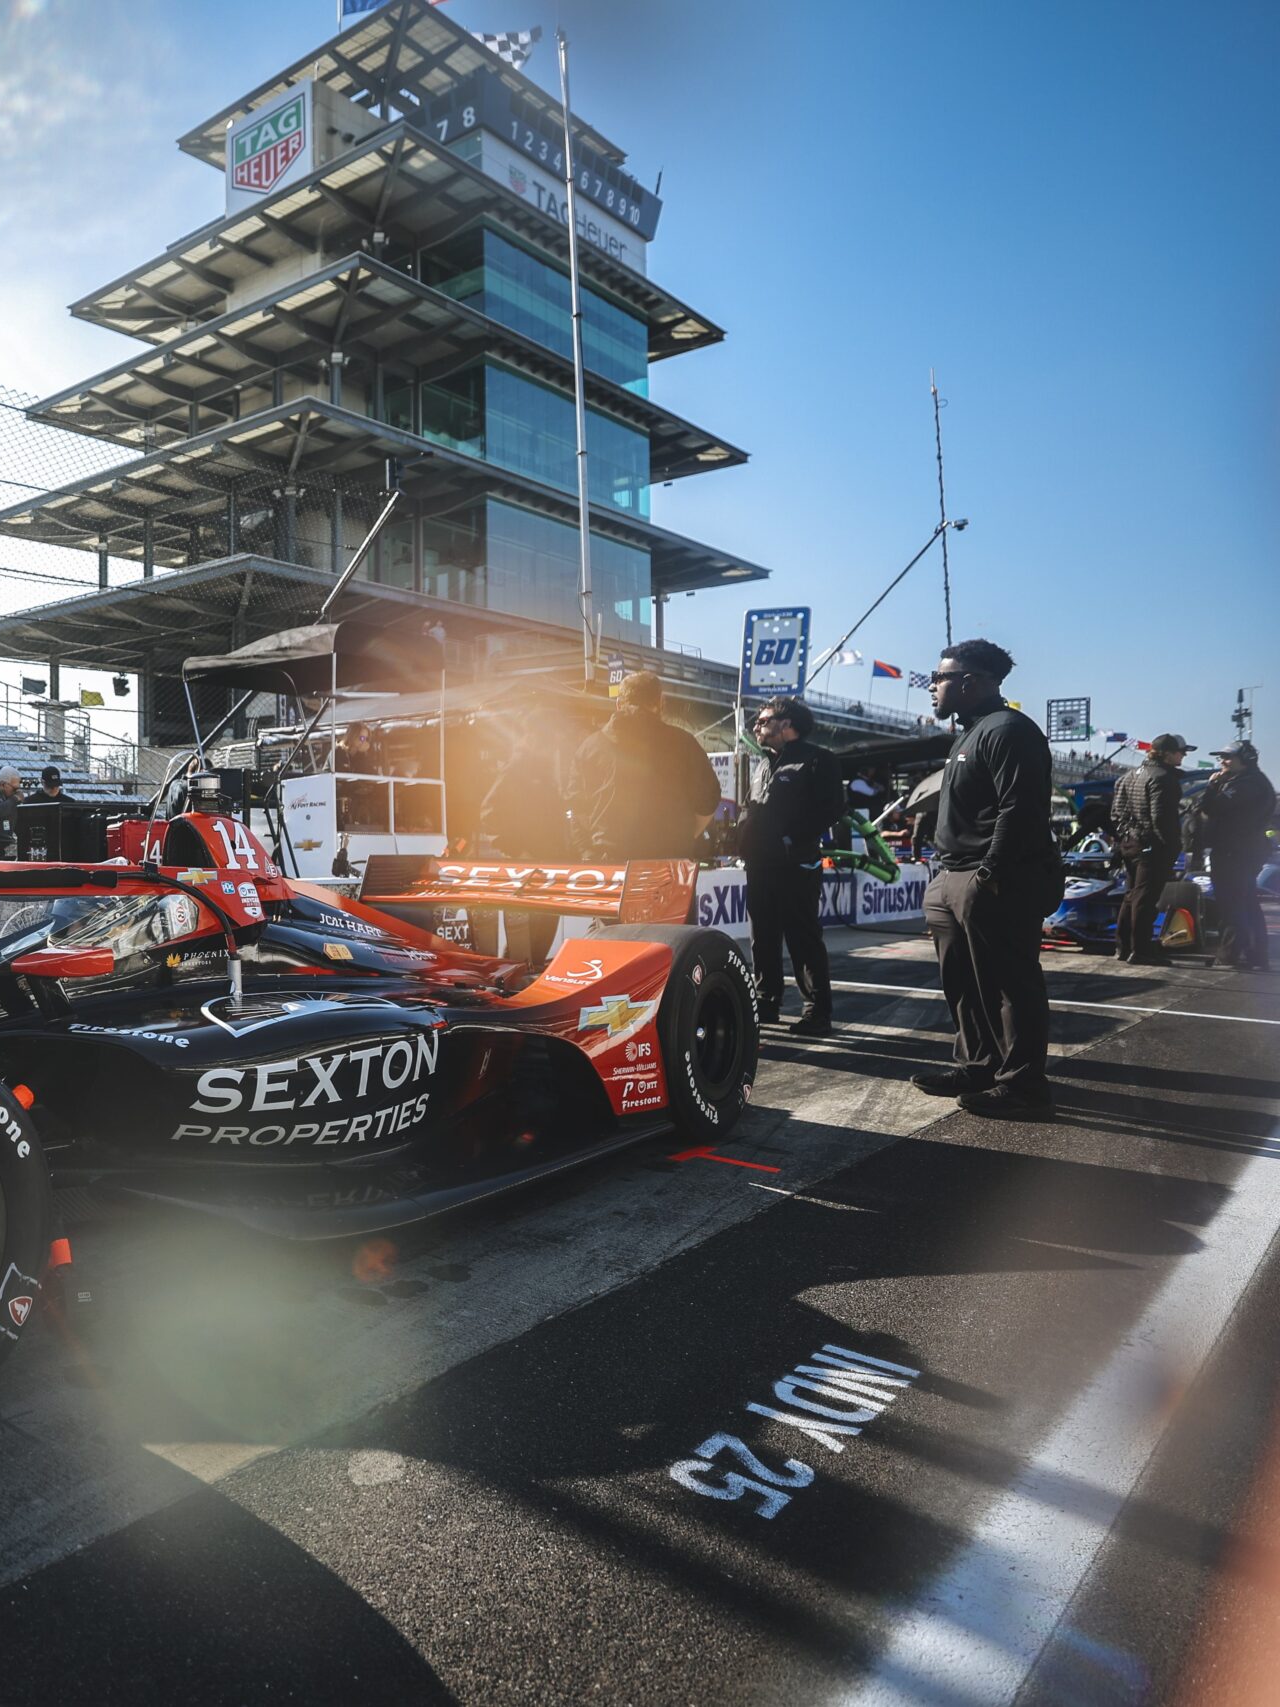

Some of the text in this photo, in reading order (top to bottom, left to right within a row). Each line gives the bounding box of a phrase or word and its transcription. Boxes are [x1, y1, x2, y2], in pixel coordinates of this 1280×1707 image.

[239, 106, 297, 156] TAG
[436, 106, 476, 142] 7 8
[236, 133, 300, 188] HEUER
[511, 121, 640, 226] 1 2 3 4 6 7 8 9 10
[754, 638, 797, 666] 60
[212, 820, 259, 870] 14
[862, 880, 927, 916] SiriusXM
[346, 918, 385, 938] HART
[183, 948, 231, 961] PHOENIX
[727, 949, 760, 1024] Firestone
[68, 1023, 190, 1049] Firestone
[637, 1042, 652, 1058] IFS
[190, 1029, 440, 1114] SEXTON
[684, 1050, 719, 1125] Firestone
[170, 1092, 431, 1146] PROPERTIES
[621, 1096, 662, 1112] Firestone
[670, 1343, 921, 1520] INDY 25
